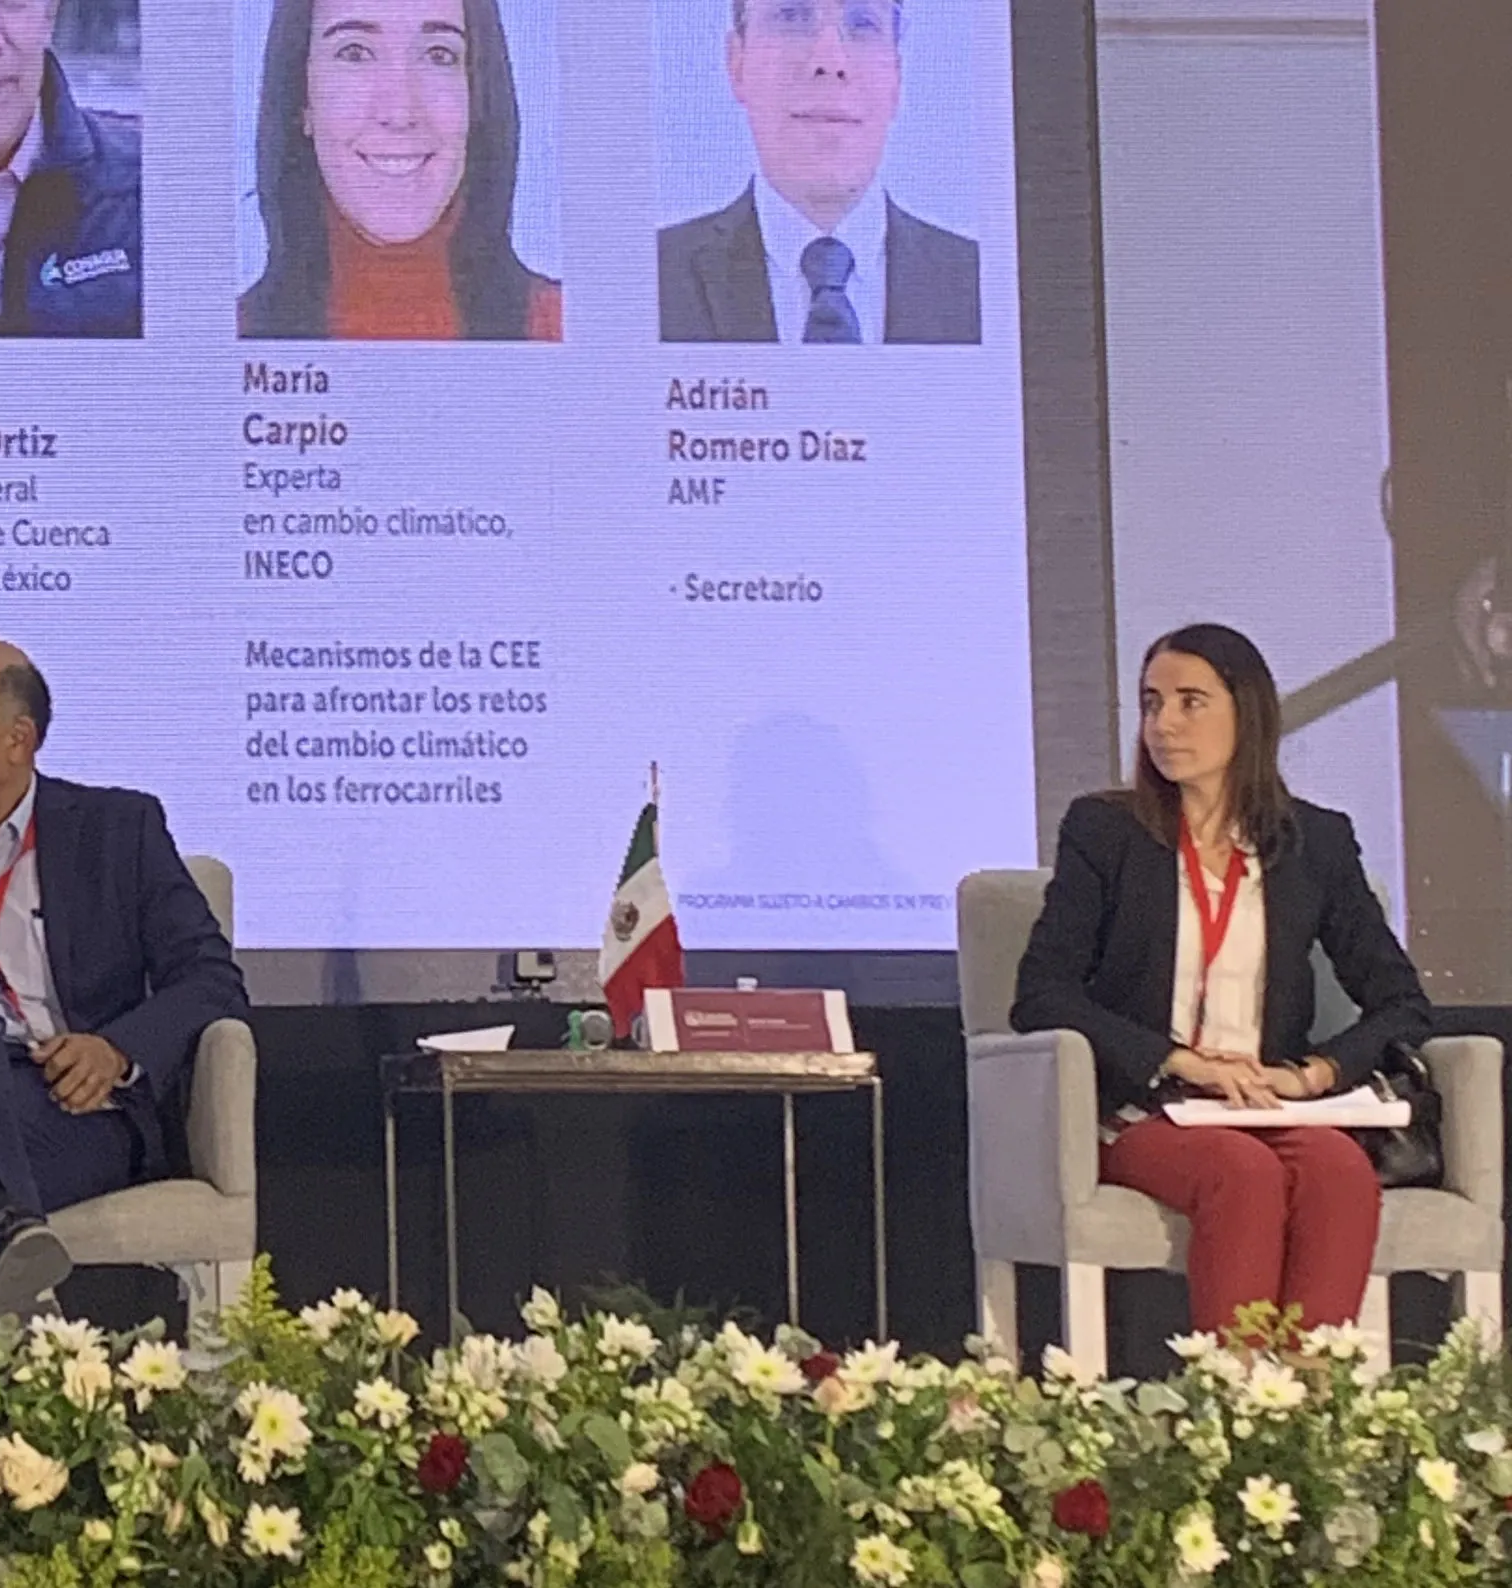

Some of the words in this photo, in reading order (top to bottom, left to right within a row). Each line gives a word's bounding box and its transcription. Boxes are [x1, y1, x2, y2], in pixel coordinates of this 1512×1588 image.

[242, 362, 330, 395] María
[666, 378, 769, 411] Adrián
[242, 412, 348, 453] Carpio
[668, 429, 791, 462] Romero
[799, 430, 868, 462] Díaz
[243, 462, 341, 497] Experta
[667, 478, 727, 505] AMF
[11, 519, 111, 547] Cuenca
[243, 510, 274, 535] en
[282, 507, 378, 536] cambio
[387, 507, 515, 540] climático,
[244, 549, 334, 580] INECO
[684, 572, 824, 602] Secretario
[245, 640, 413, 669] Mecanismos
[418, 640, 452, 669] de
[459, 640, 482, 669] la
[489, 640, 541, 669] CEE
[245, 690, 306, 720] para
[312, 686, 426, 714] afrontar
[432, 686, 472, 714] los
[478, 688, 548, 714] retos
[245, 730, 289, 759] del
[295, 730, 396, 759] cambio
[402, 730, 529, 759] climático
[246, 779, 279, 804] en
[287, 776, 327, 804] los
[333, 776, 503, 805] ferrocarriles
